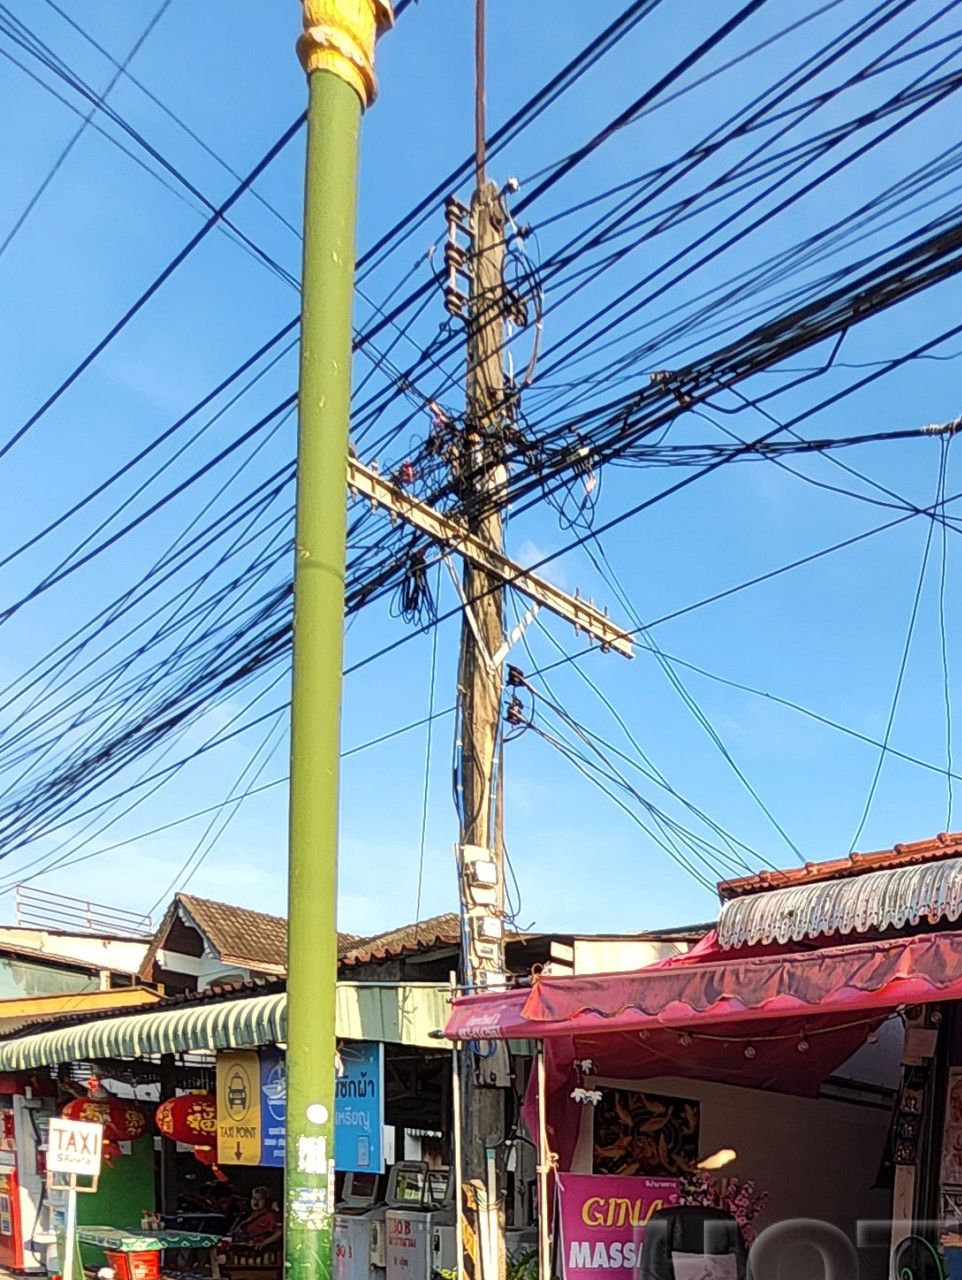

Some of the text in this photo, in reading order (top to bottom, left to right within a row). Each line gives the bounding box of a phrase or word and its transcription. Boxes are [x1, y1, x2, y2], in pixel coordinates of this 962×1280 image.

[53, 1128, 98, 1155] TAXI
[220, 1126, 235, 1139] TAXI
[236, 1127, 257, 1139] POINT
[568, 1241, 645, 1268] MASS
